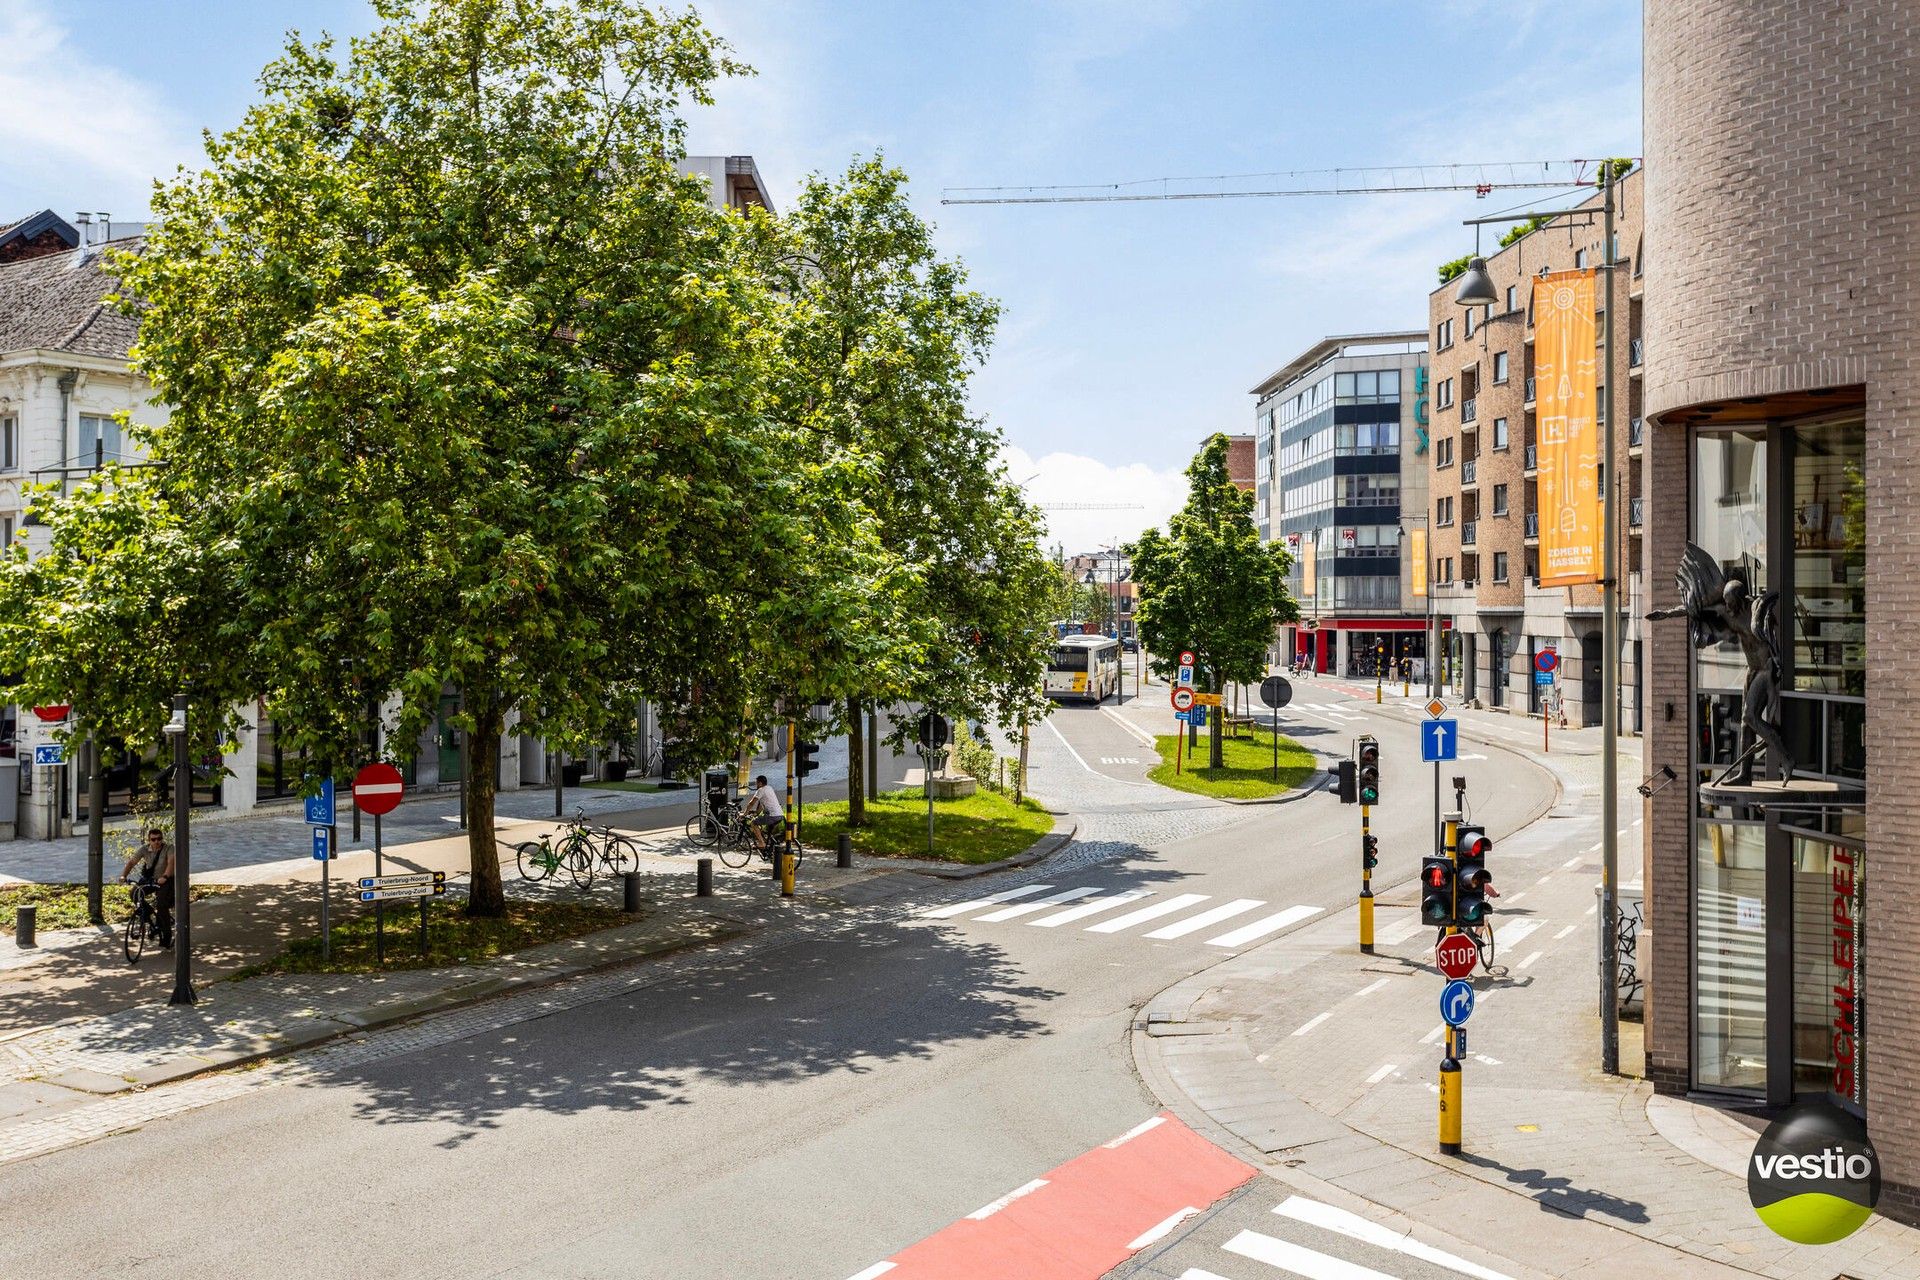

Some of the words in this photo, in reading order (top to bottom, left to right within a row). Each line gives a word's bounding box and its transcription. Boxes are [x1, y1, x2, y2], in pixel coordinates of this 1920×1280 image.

[1548, 547, 1579, 558] ZOMER
[1582, 545, 1592, 555] IN
[1549, 556, 1593, 568] HASSELT
[378, 875, 429, 885] Truierbrug-Noord
[381, 888, 427, 898] Truierbrug-Zuid
[1439, 947, 1475, 968] STOP
